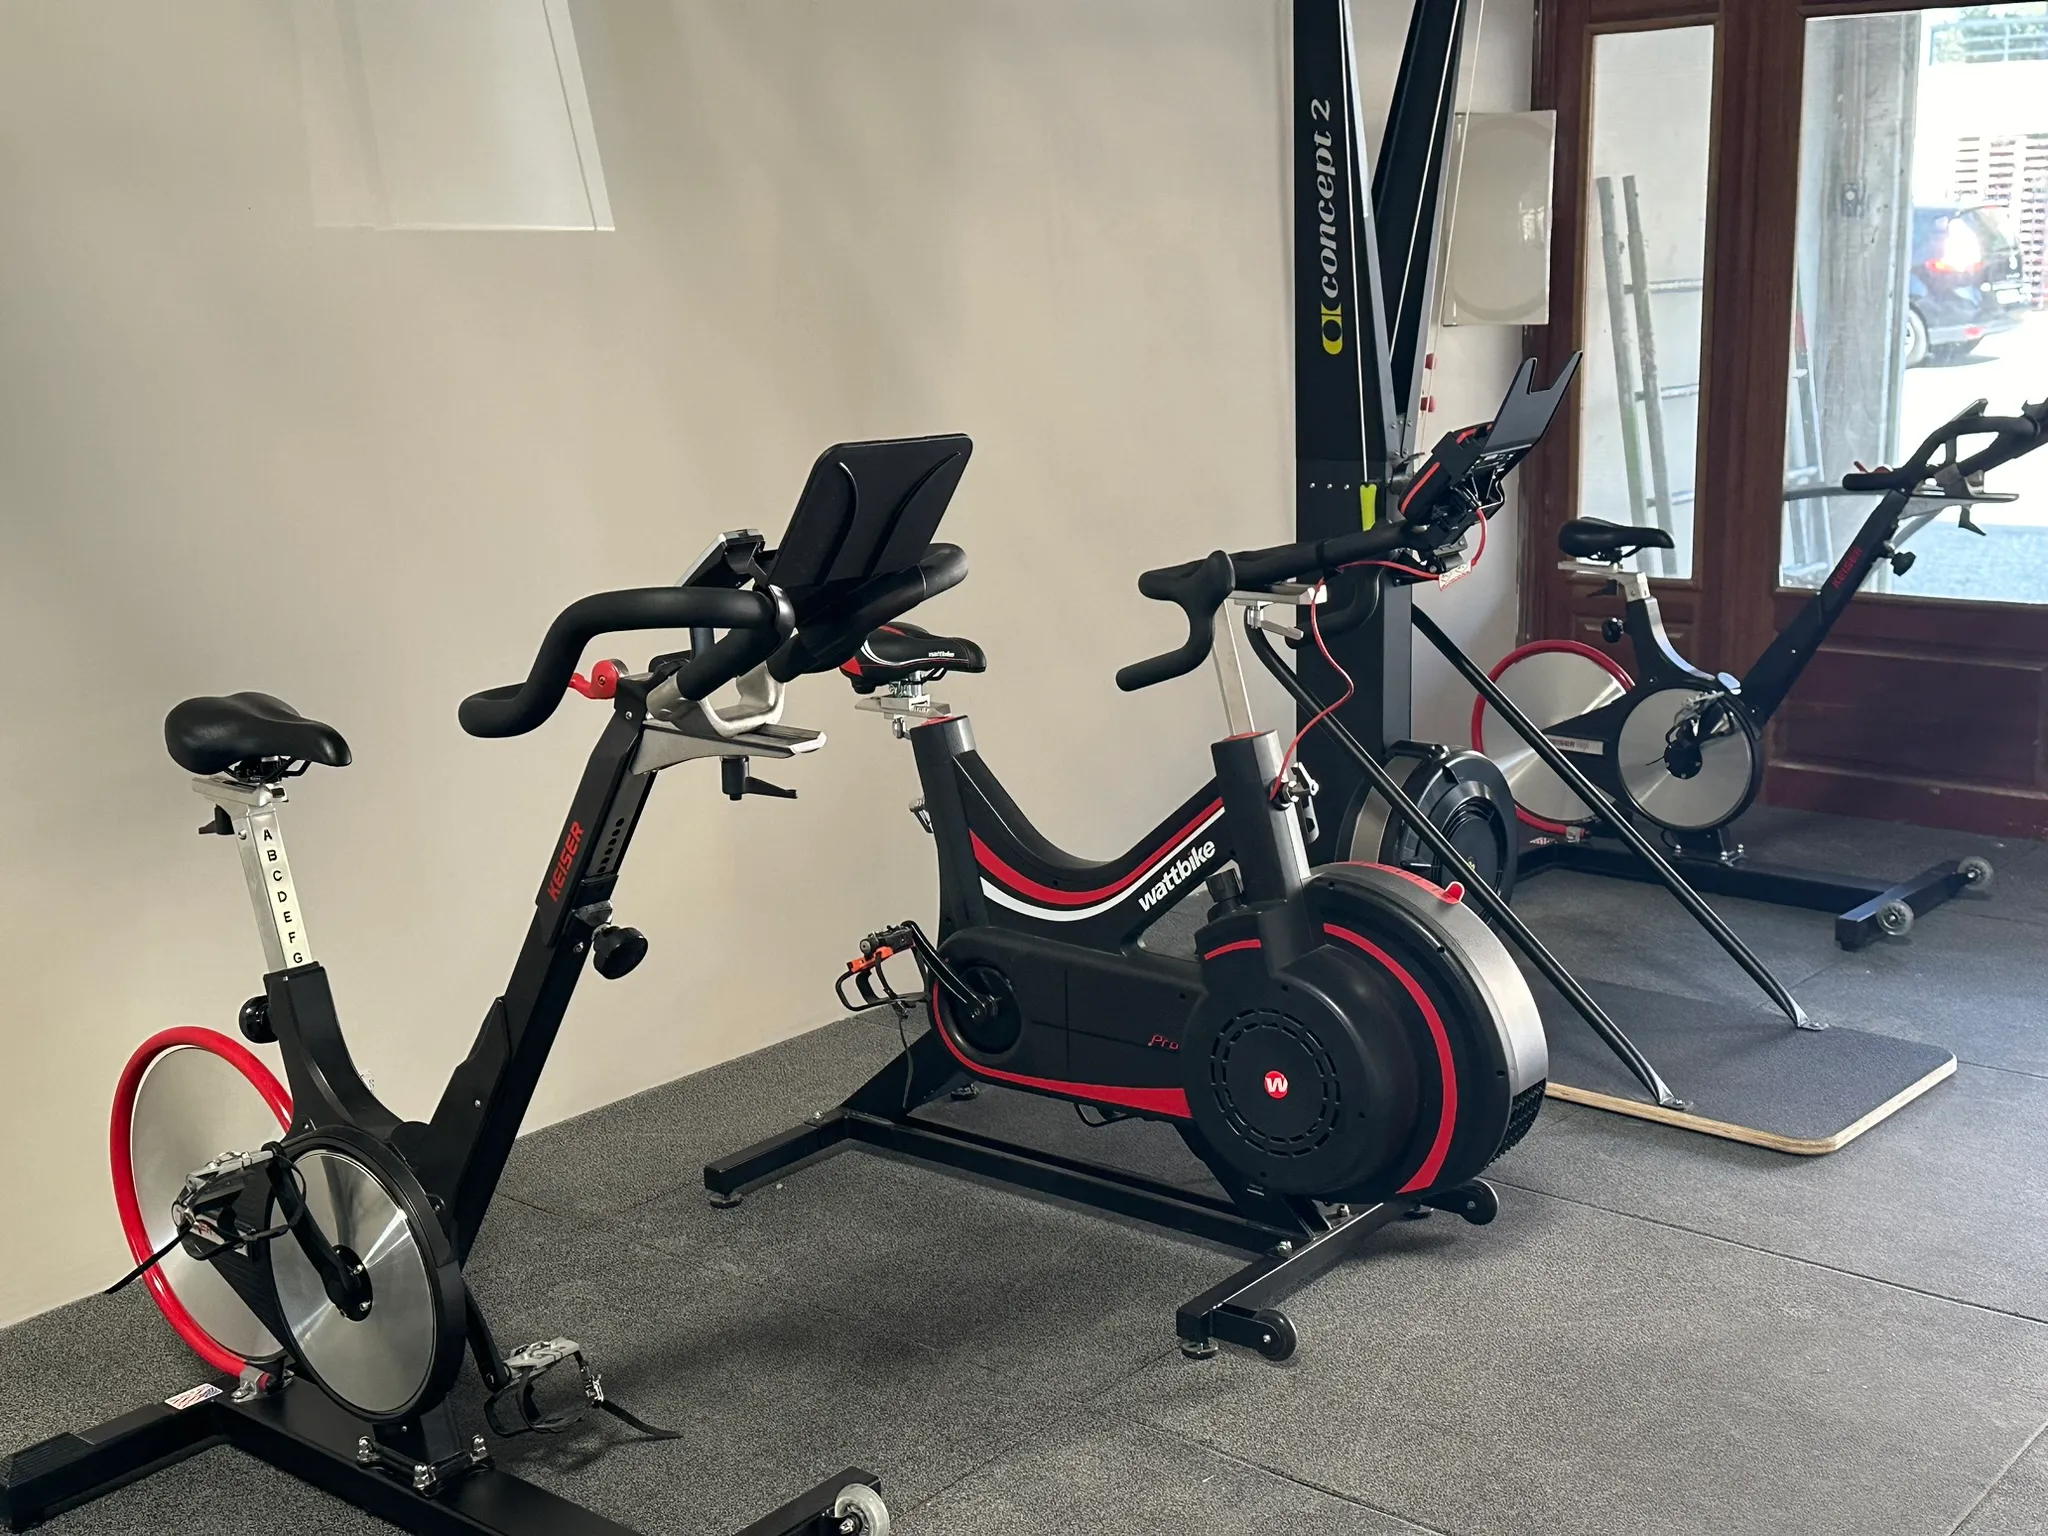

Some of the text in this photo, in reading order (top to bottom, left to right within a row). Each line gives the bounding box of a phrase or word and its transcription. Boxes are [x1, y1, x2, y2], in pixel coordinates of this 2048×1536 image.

[1310, 98, 1339, 299] concept 2
[263, 829, 273, 841] A
[267, 850, 278, 861] B
[547, 821, 584, 902] KEISER
[272, 870, 283, 881] C
[1138, 841, 1216, 912] wattbike
[277, 891, 287, 902] D
[283, 911, 292, 923] E
[288, 931, 296, 943] F
[293, 952, 303, 963] G
[1147, 1034, 1179, 1050] Pro
